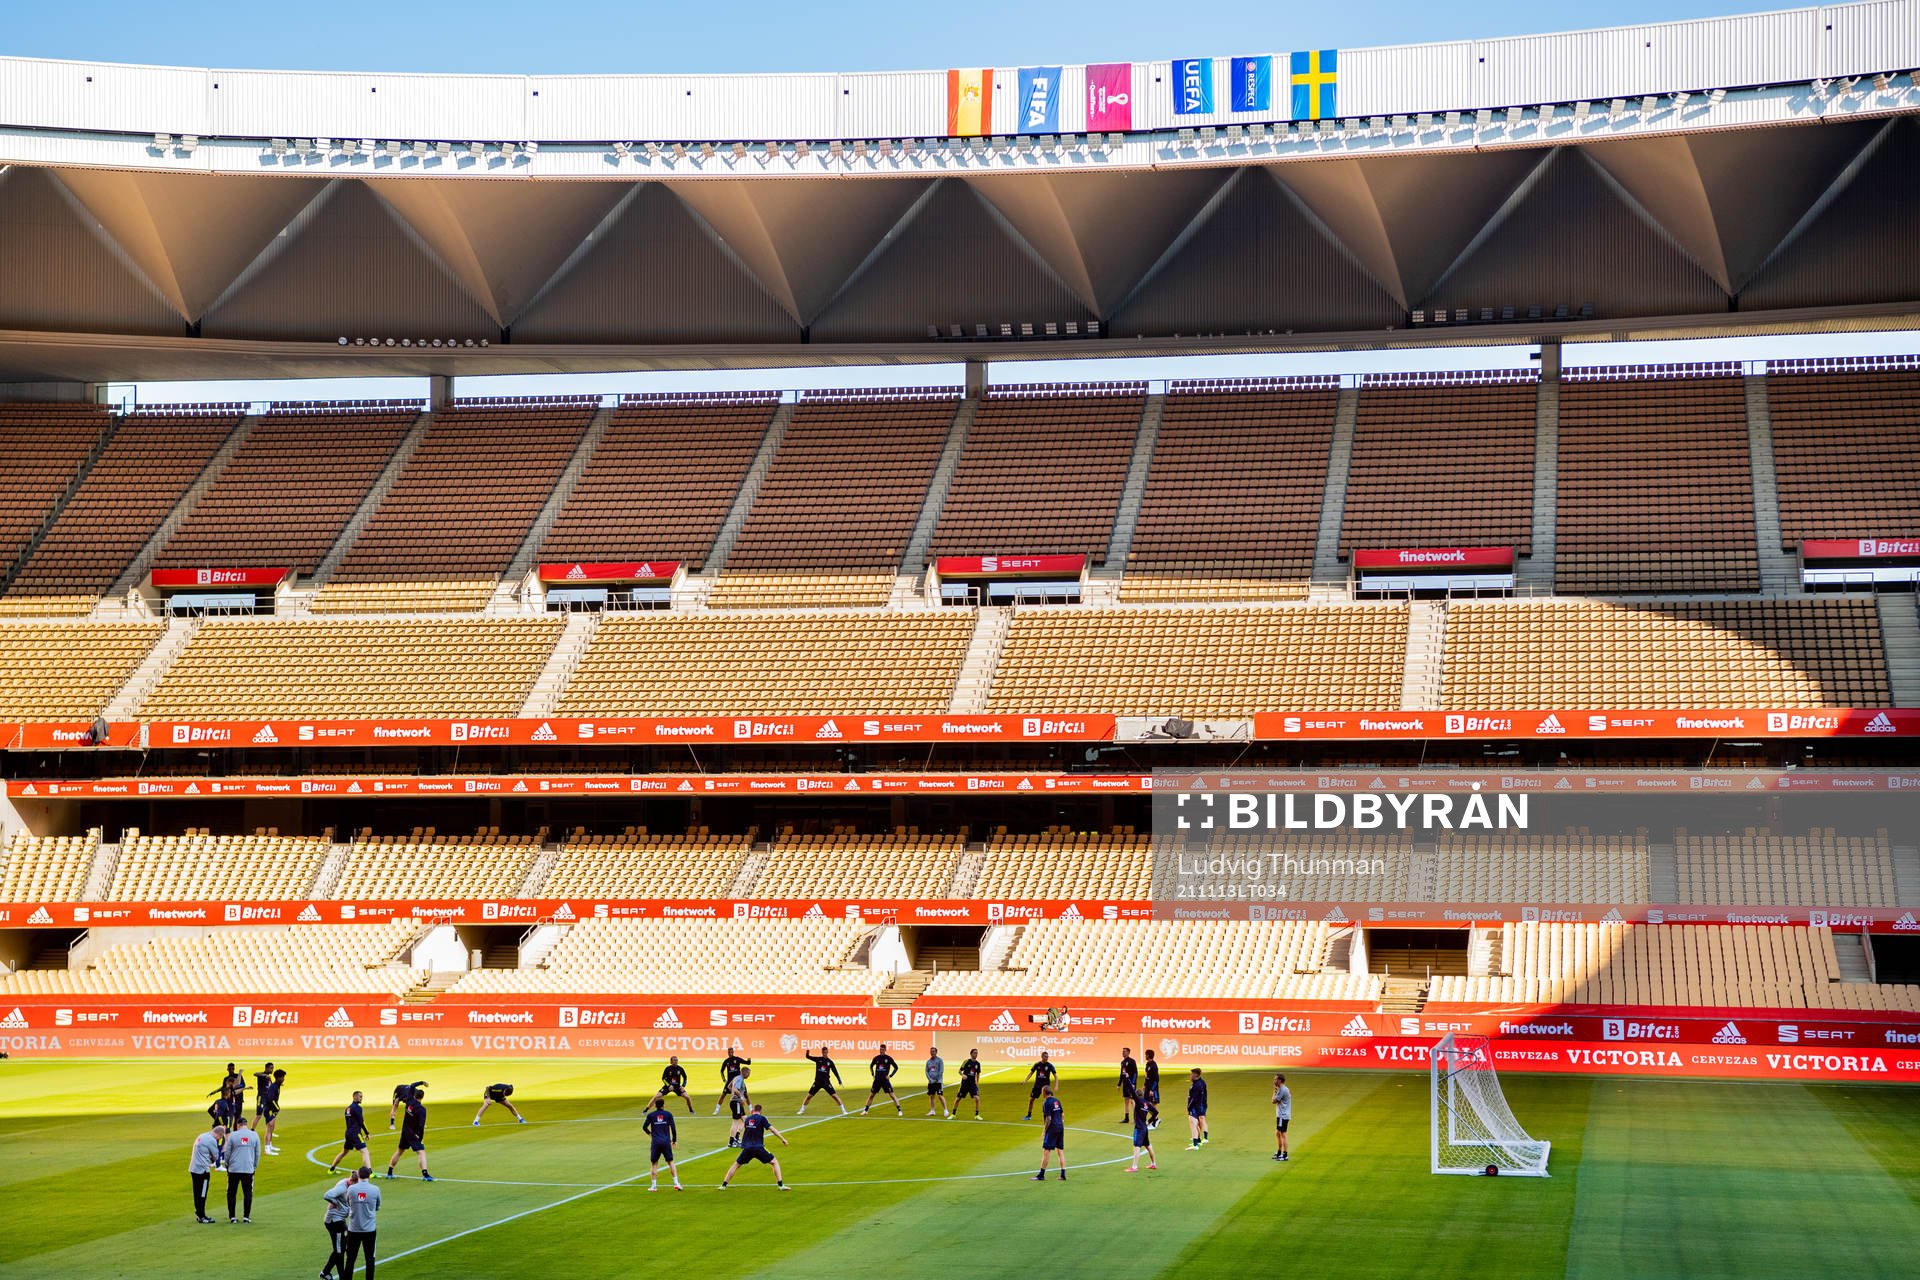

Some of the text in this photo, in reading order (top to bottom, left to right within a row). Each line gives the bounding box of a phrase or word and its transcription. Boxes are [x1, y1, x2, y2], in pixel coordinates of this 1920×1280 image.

[1185, 61, 1201, 111] UEFA
[1247, 73, 1255, 107] RESPECT
[1028, 77, 1049, 128] FIFA
[1001, 559, 1041, 567] SEAT
[1398, 550, 1466, 562] finetwork
[318, 728, 355, 737] SEAT
[373, 727, 432, 738] finetwork
[598, 726, 635, 735] SEAT
[654, 725, 714, 736] finetwork
[884, 724, 922, 732] SEAT
[941, 723, 1003, 734] finetwork
[1305, 720, 1346, 729] SEAT
[1359, 719, 1424, 731] finetwork
[1611, 719, 1654, 727] SEAT
[1675, 717, 1745, 729] finetwork
[148, 908, 207, 919] finetwork
[411, 907, 465, 918] finetwork
[662, 906, 716, 917] finetwork
[914, 907, 970, 917] finetwork
[77, 1012, 119, 1022] SEAT
[142, 1011, 208, 1023] finetwork
[402, 1012, 444, 1021] SEAT
[467, 1011, 534, 1024] finetwork
[732, 1013, 775, 1023] SEAT
[799, 1013, 868, 1026] finetwork
[1070, 1016, 1115, 1026] SEAT
[1140, 1016, 1212, 1029] finetwork
[1425, 1021, 1472, 1032] SEAT
[1498, 1021, 1574, 1035] finetwork
[1804, 1030, 1855, 1040] SEAT
[68, 1039, 126, 1048] CERVEZAS
[131, 1036, 231, 1050] VICTORIA
[237, 1038, 295, 1047] CERVEZAS
[300, 1035, 401, 1050] VICTORIA
[407, 1038, 464, 1047] CERVEZAS
[470, 1036, 571, 1051] VICTORIA
[577, 1040, 635, 1048] CERVEZAS
[642, 1037, 745, 1052] VICTORIA
[800, 1040, 855, 1051] EUROPEAN
[1181, 1044, 1303, 1057] EUROPEAN QUALIFIERS
[1317, 1047, 1367, 1057] RVEZAS
[1494, 1051, 1559, 1061] CERVEZAS
[1566, 1050, 1684, 1067] VICTORIA
[1691, 1056, 1758, 1065] CERVEZAS
[1765, 1054, 1888, 1072] VICTORIA
